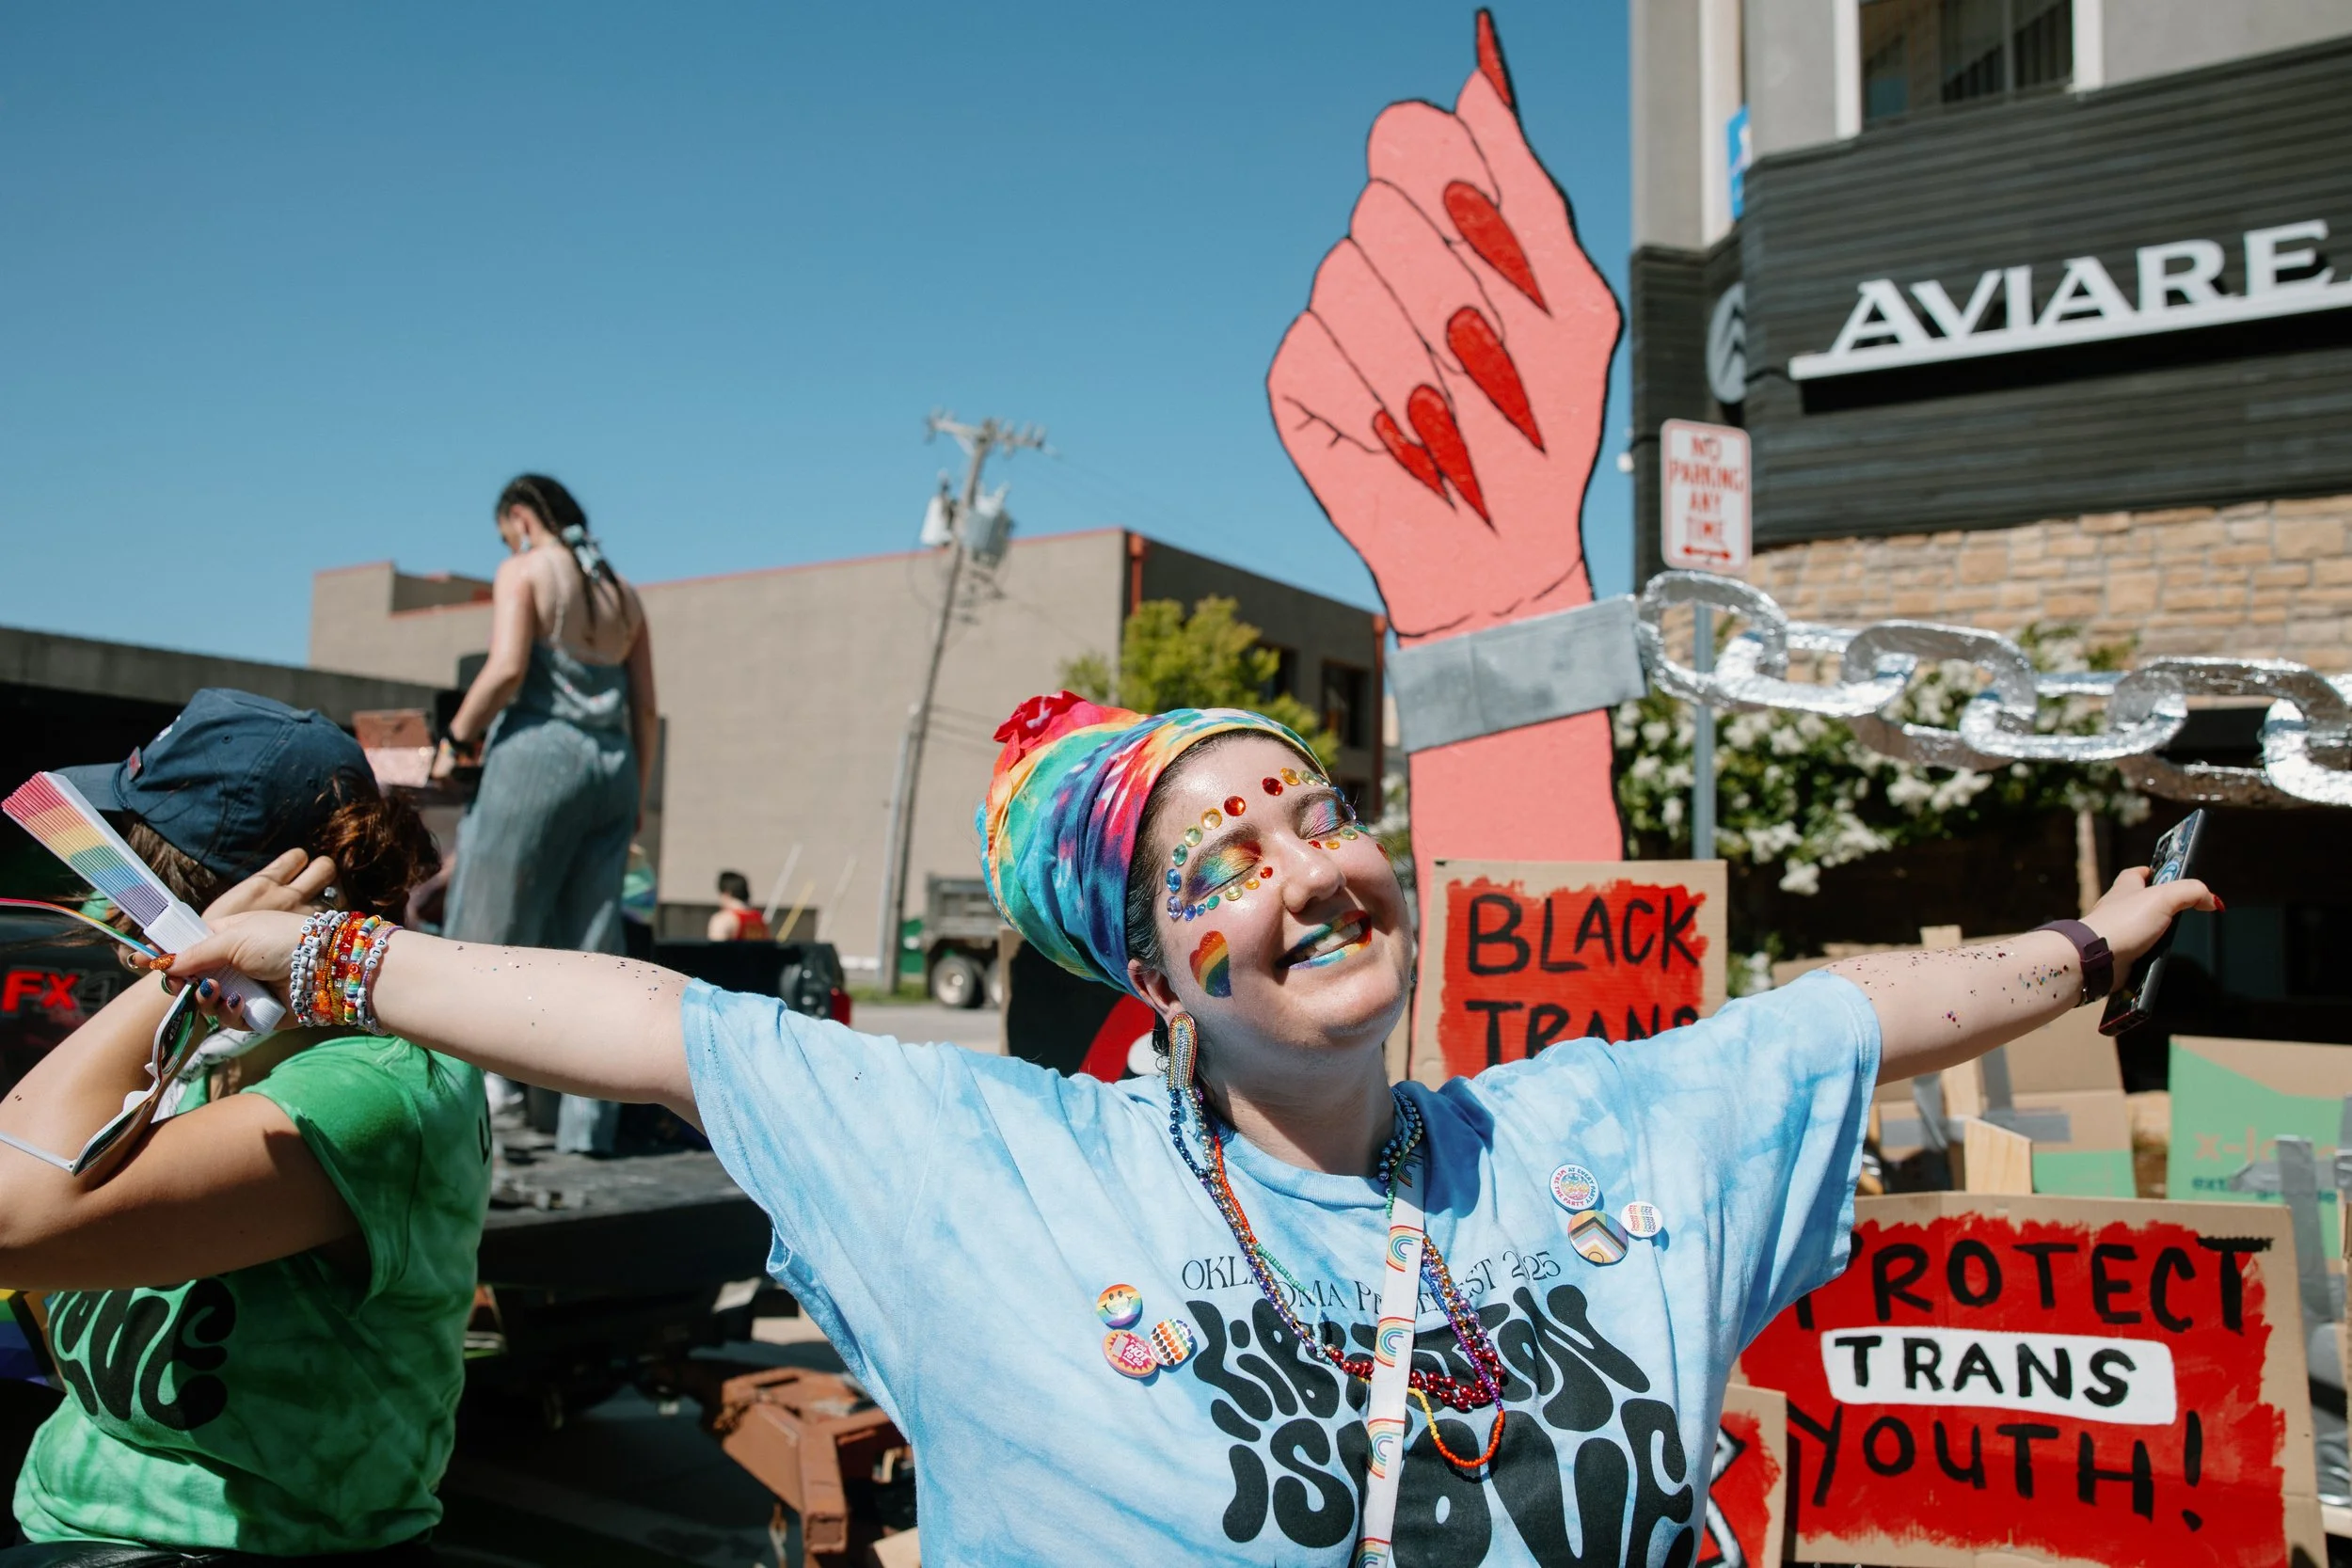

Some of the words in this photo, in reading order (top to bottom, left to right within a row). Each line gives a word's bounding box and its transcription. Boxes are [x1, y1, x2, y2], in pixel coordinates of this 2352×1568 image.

[1829, 218, 2336, 356] AVIARE
[1691, 436, 1722, 460] NO
[1669, 459, 1744, 491] PARKING
[1689, 490, 1722, 513] ANY
[1685, 515, 1726, 544] TIME
[1468, 894, 1699, 975] BLACK
[1554, 1186, 1563, 1198] THE
[1563, 1197, 1584, 1207] PARTY
[1577, 1168, 1595, 1184] EVERY
[1586, 1185, 1597, 1204] PARTY
[1182, 1255, 1347, 1309] OKLOMA
[1126, 1344, 1149, 1361] HOT
[1835, 1336, 2137, 1407] TRANS
[1787, 1399, 2204, 1532] YOUTH!
